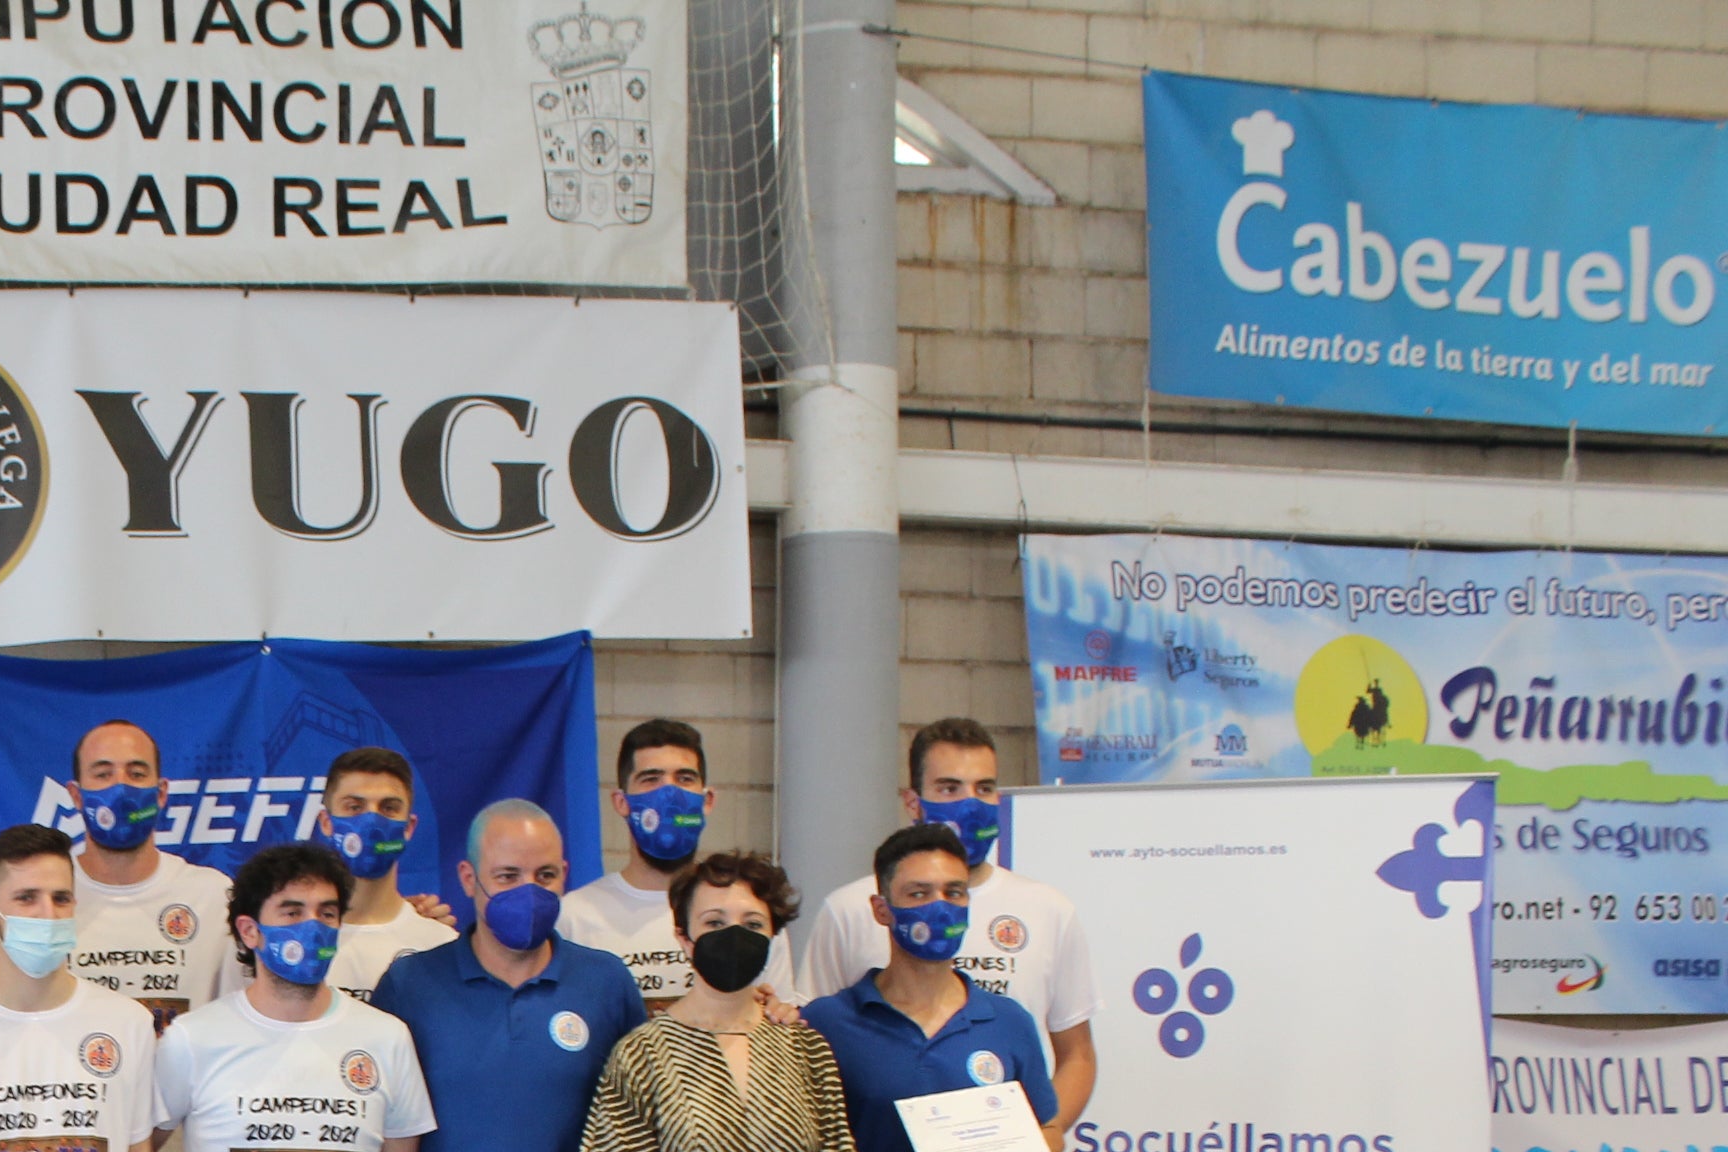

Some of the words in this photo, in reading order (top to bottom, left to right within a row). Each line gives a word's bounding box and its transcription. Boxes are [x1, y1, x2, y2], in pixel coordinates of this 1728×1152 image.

[272, 175, 509, 238] REAL
[1216, 182, 1715, 326] Cabezuelo
[1215, 322, 1381, 365] Alimentos
[1388, 335, 1427, 368] de
[1435, 339, 1464, 373] la
[1470, 346, 1553, 382] tierra
[1563, 358, 1581, 390] y
[1590, 352, 1640, 385] del
[1649, 361, 1713, 388] mar
[74, 389, 720, 543] YUGO
[1111, 560, 1166, 601] No
[1175, 565, 1340, 613] podemos
[1347, 577, 1497, 622] predecir
[1507, 577, 1536, 615] el
[1666, 592, 1728, 632] per
[1053, 665, 1138, 682] MAPFRE
[1440, 665, 1728, 746] Peñarrubi
[1517, 816, 1560, 851] de
[1572, 818, 1710, 859] Seguros
[76, 950, 176, 967] CAMPEONES
[1490, 957, 1587, 973] agroseguro
[1653, 957, 1721, 978] asisa
[249, 1097, 358, 1116] CAMPEONES
[1491, 1055, 1679, 1115] ROVINCIAL
[246, 1123, 296, 1142] 2020
